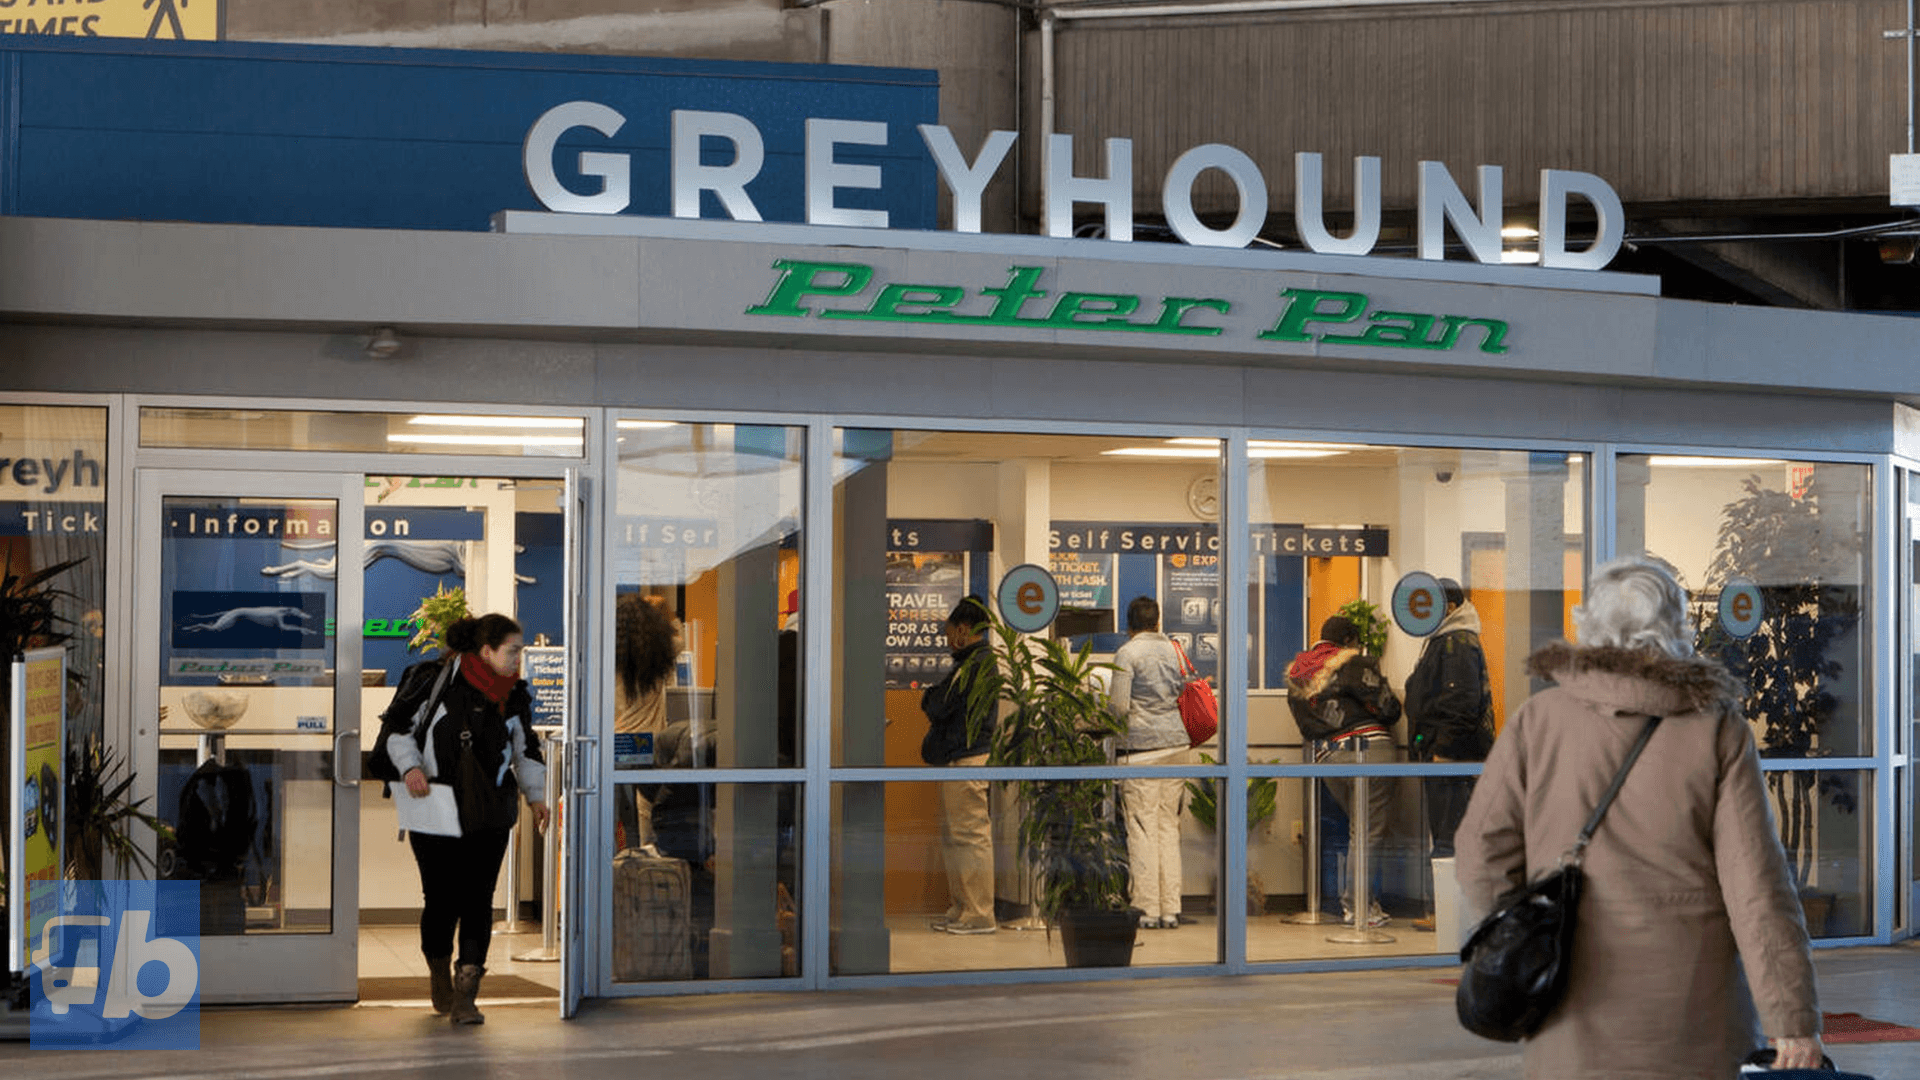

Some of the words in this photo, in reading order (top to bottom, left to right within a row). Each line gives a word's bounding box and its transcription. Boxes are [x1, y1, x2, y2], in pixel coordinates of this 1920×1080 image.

[523, 101, 1626, 270] GREYHOUND
[745, 258, 1230, 335] Peter
[1257, 288, 1509, 354] Pan
[1049, 530, 1109, 549] Self
[1251, 533, 1366, 552] Tickets
[1017, 582, 1044, 615] e
[1408, 588, 1433, 619] e
[1732, 592, 1752, 622] e
[889, 623, 917, 634] FOR
[920, 623, 938, 634] AS
[913, 635, 931, 647] AS
[298, 721, 326, 729] PULL
